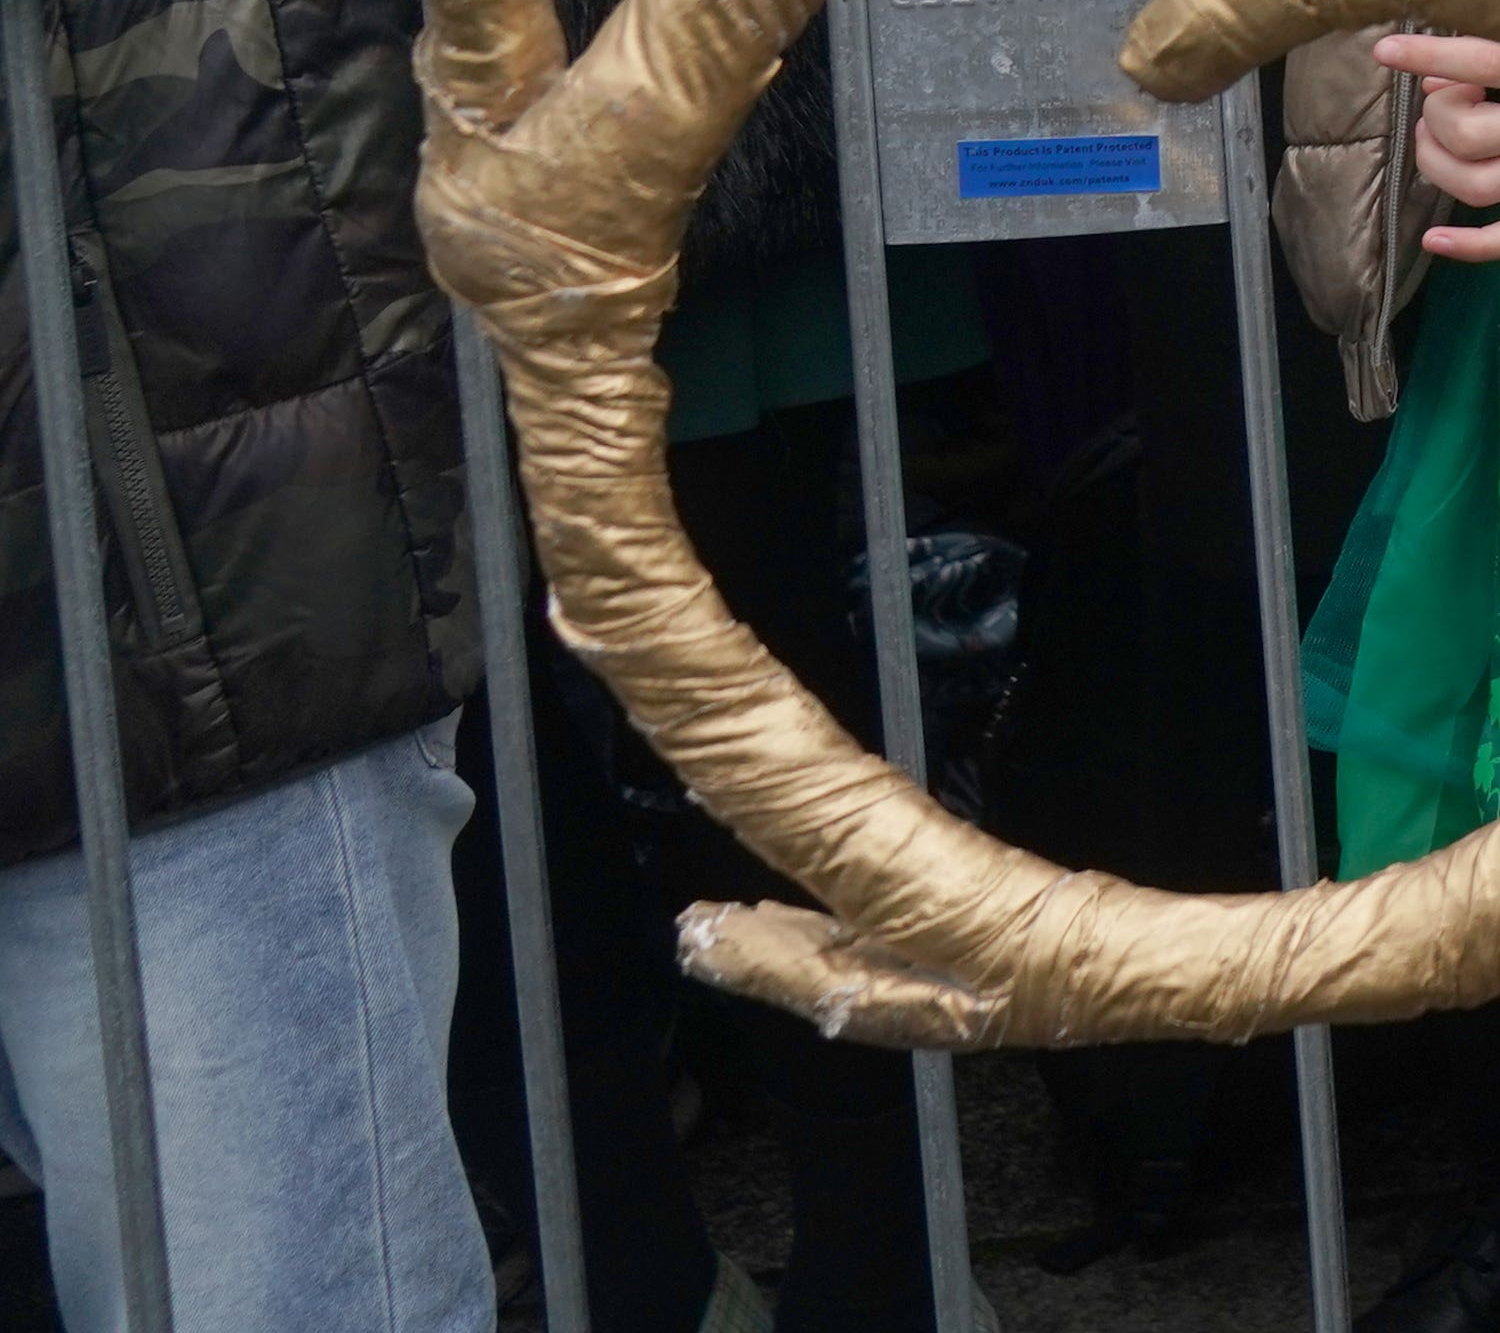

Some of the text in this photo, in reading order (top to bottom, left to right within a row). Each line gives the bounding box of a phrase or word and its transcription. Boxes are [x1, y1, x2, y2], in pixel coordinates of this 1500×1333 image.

[993, 146, 1040, 157] Product
[1056, 144, 1094, 154] Patent
[1096, 141, 1153, 153] Protected
